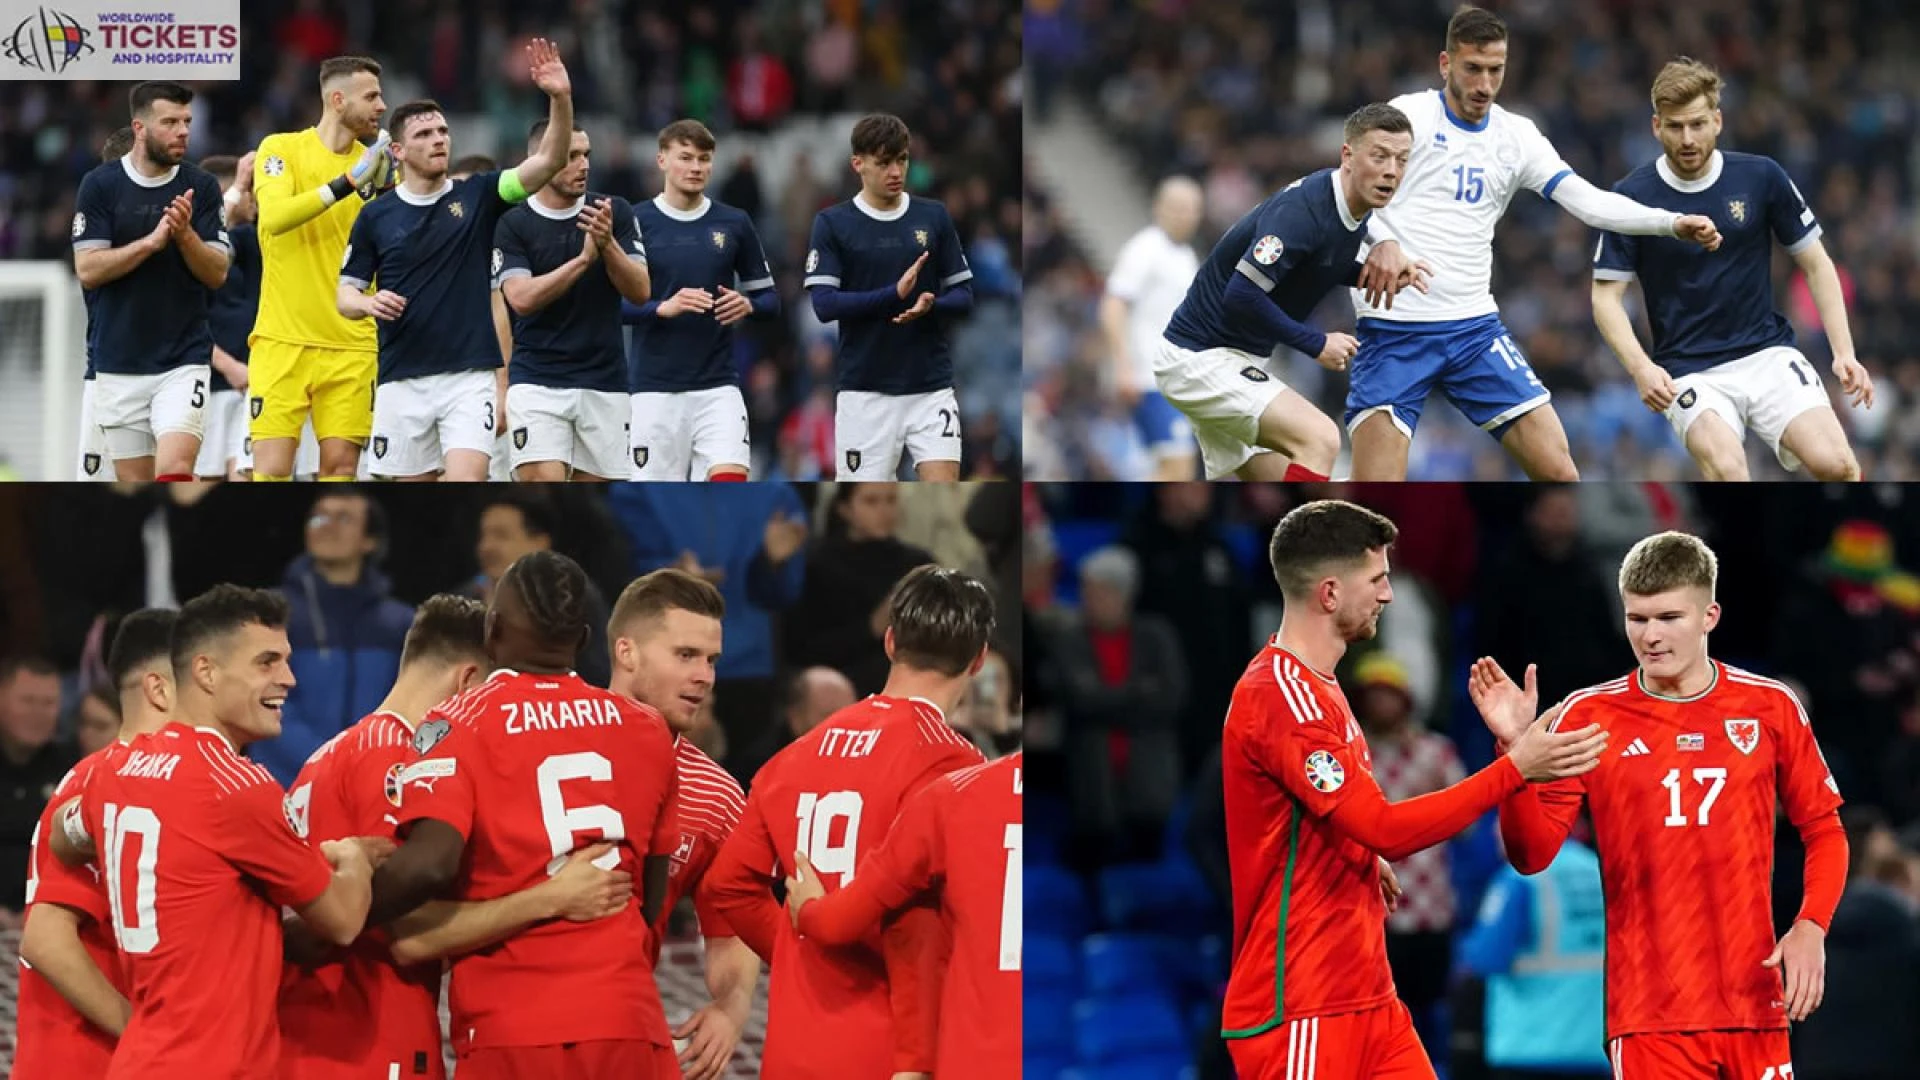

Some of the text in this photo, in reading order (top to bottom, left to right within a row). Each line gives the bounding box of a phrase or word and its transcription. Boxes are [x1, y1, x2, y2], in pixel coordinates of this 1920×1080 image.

[1452, 164, 1485, 204] 15
[1788, 360, 1820, 387] 1
[191, 379, 205, 409] 5
[484, 401, 494, 431] 3
[500, 698, 623, 735] ZAKARIA
[818, 727, 882, 758] ITTEN
[536, 751, 625, 876] 6
[1661, 767, 1727, 827] 17
[796, 790, 864, 889] 19
[103, 802, 161, 954] 10
